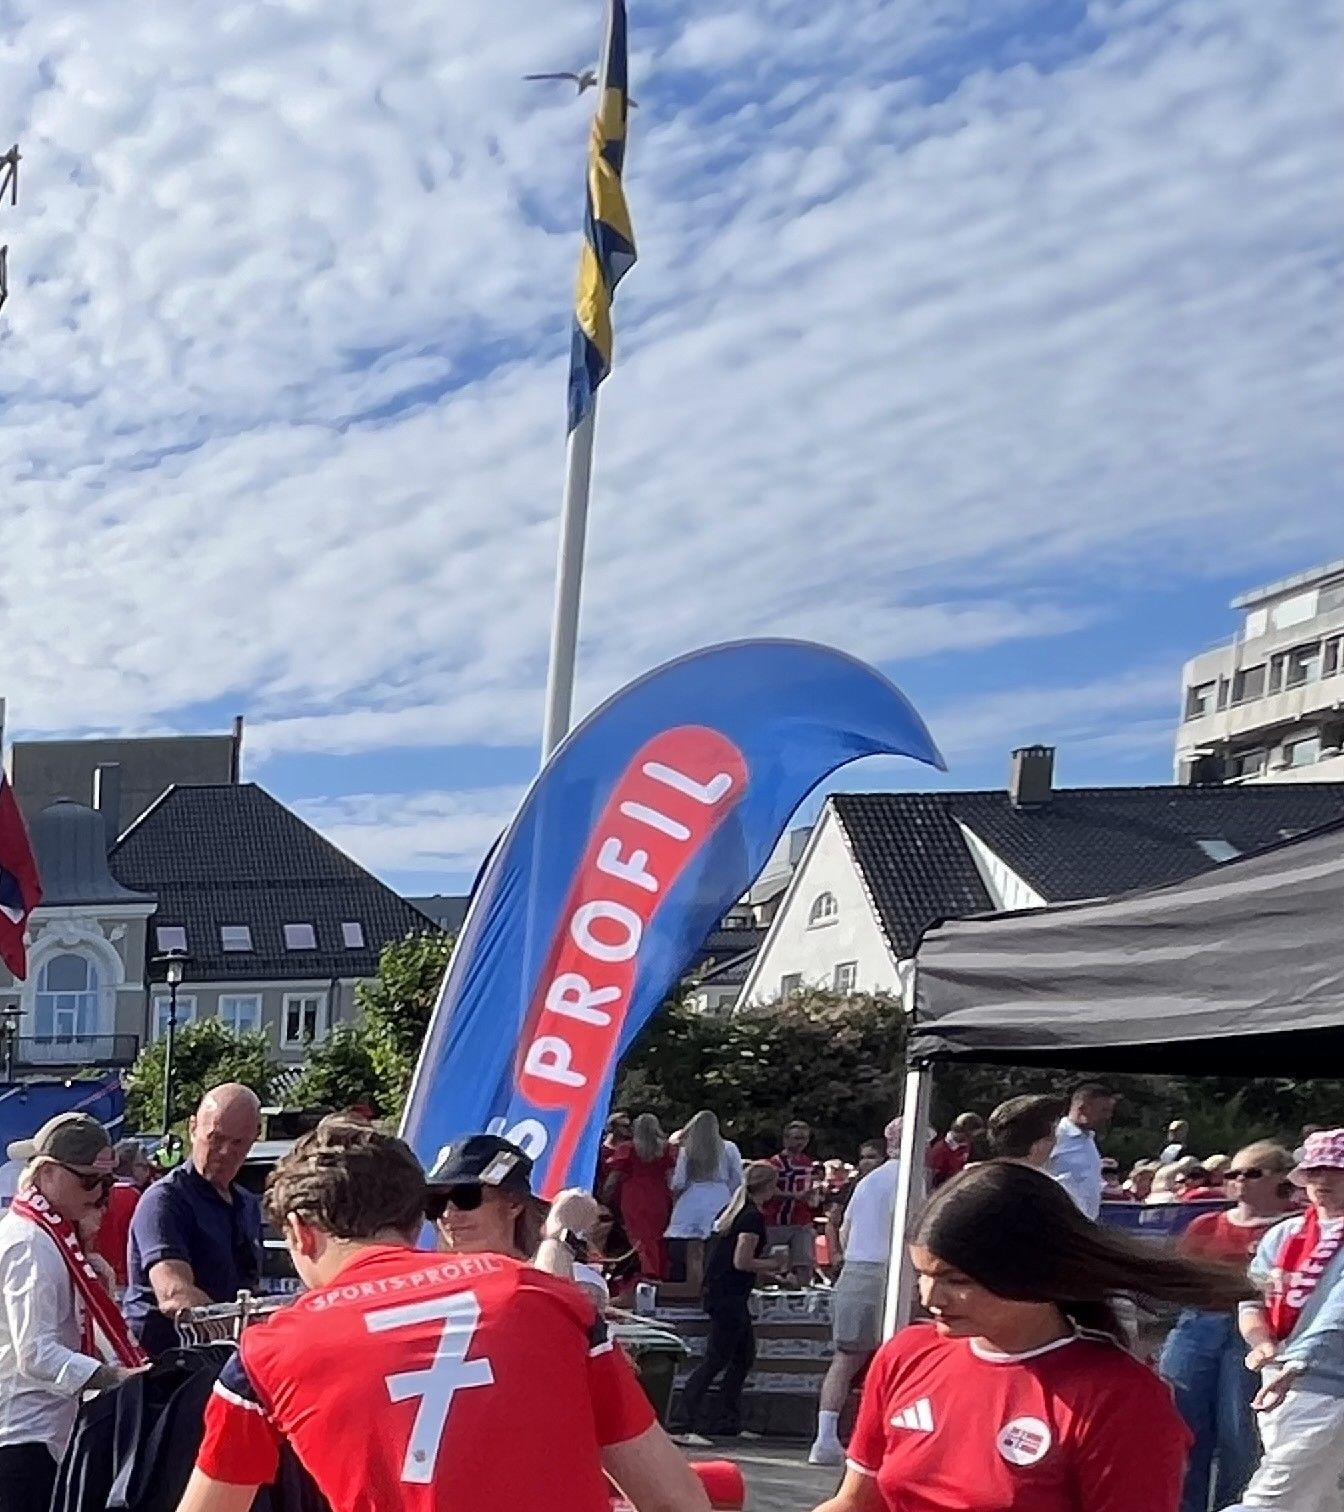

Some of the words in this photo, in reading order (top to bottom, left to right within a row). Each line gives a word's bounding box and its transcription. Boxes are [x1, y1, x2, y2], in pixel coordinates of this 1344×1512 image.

[522, 760, 733, 1089] PROFIL
[411, 1256, 503, 1288] PROFIL
[363, 1290, 495, 1486] 7
